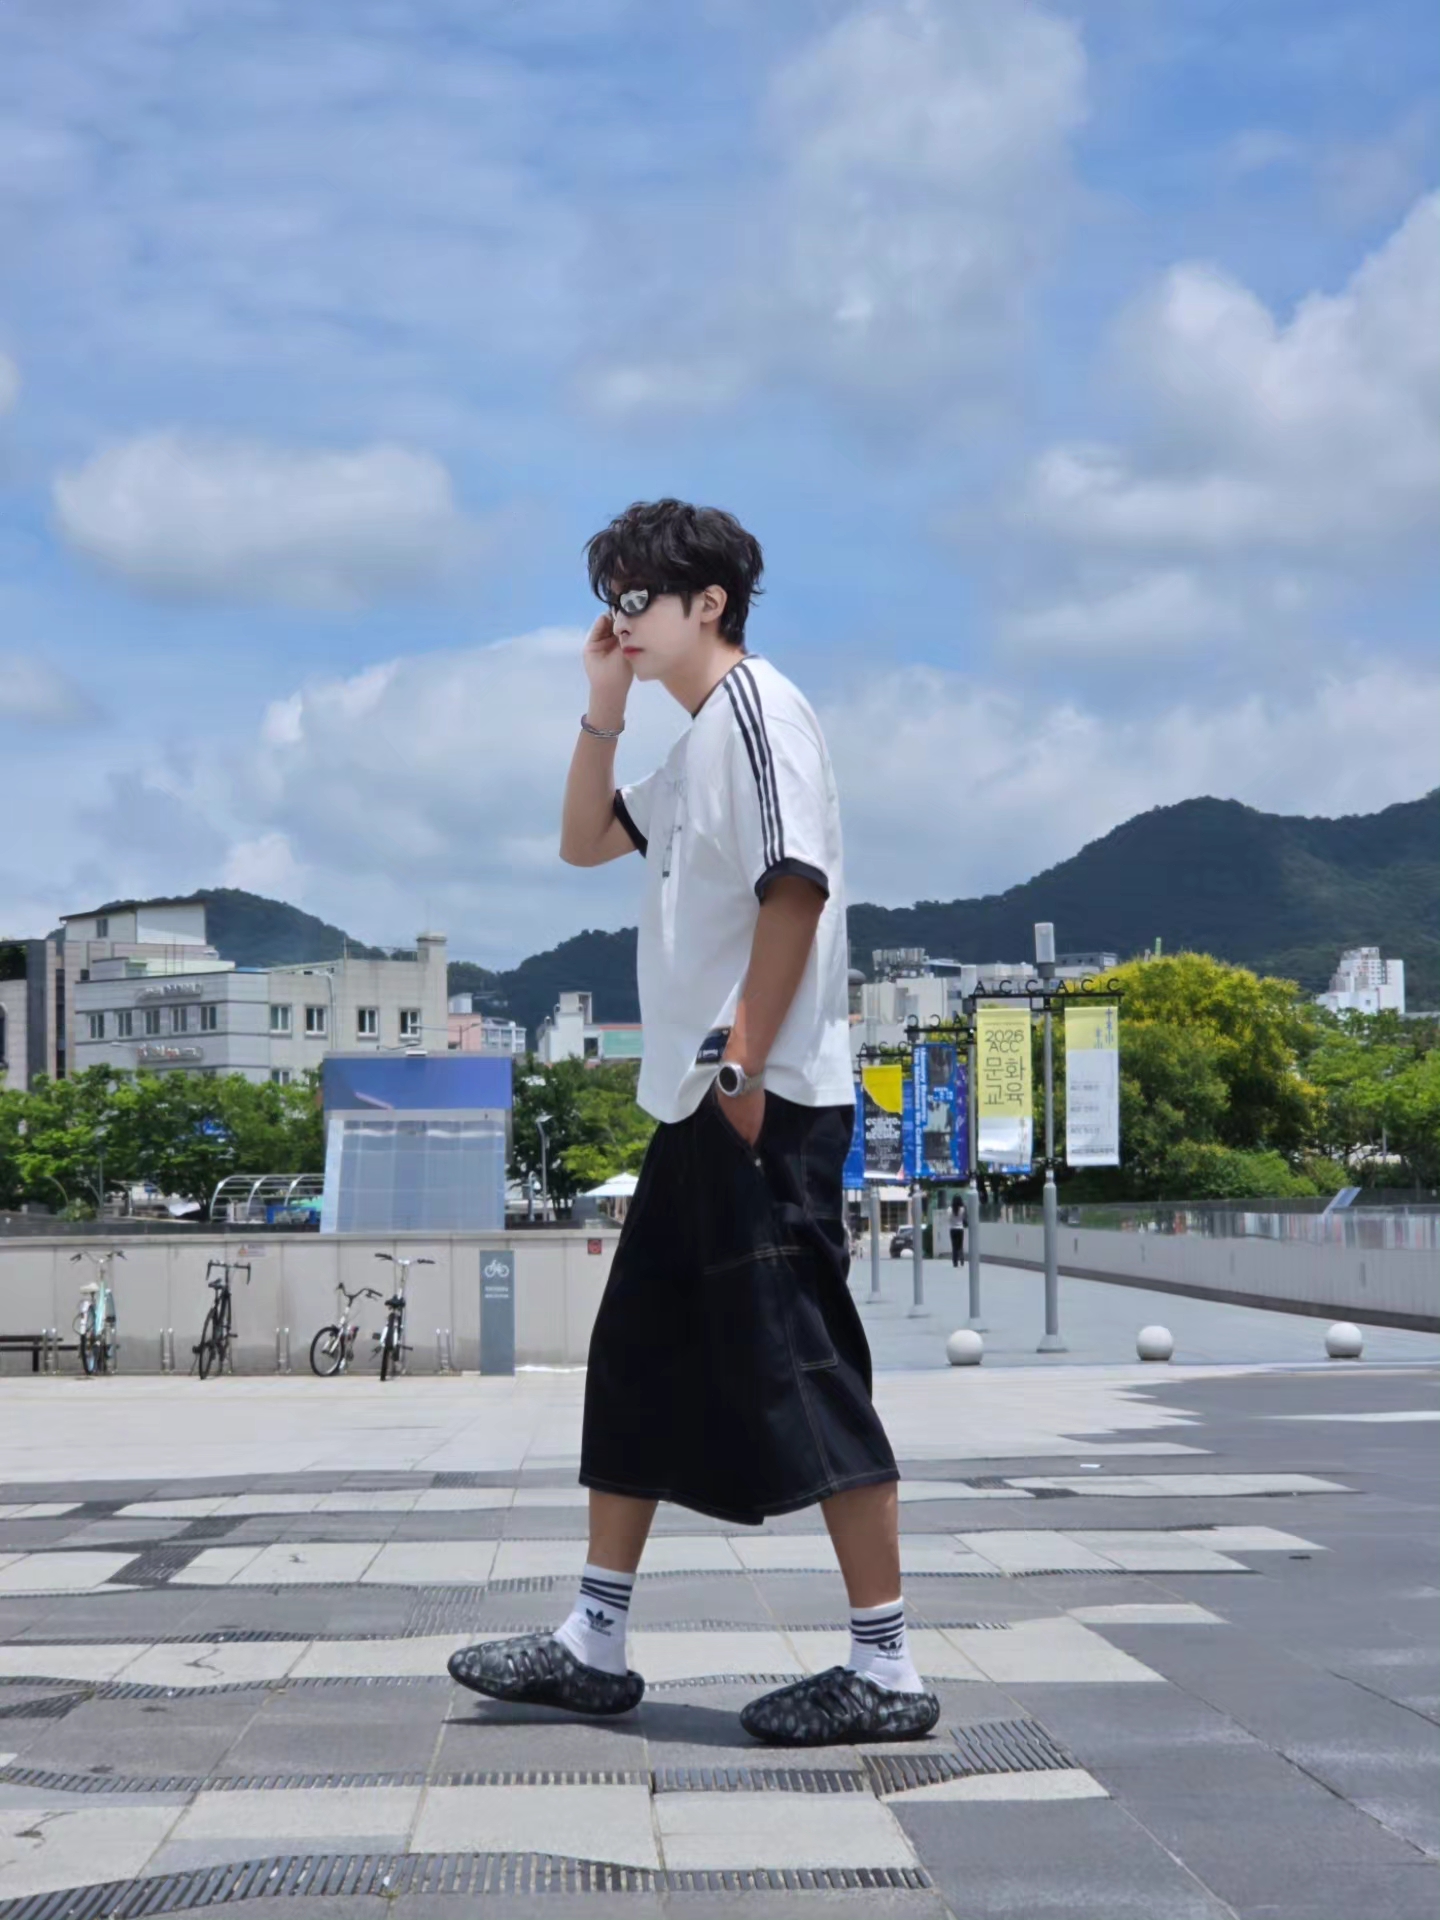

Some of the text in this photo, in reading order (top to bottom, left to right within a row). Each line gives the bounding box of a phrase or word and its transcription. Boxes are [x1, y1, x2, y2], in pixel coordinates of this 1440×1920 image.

[974, 980, 1039, 994] ACC
[1056, 979, 1121, 994] ACC
[988, 1041, 1020, 1053] ACC
[983, 1056, 1026, 1081] 문화
[983, 1082, 1025, 1106] 교육
